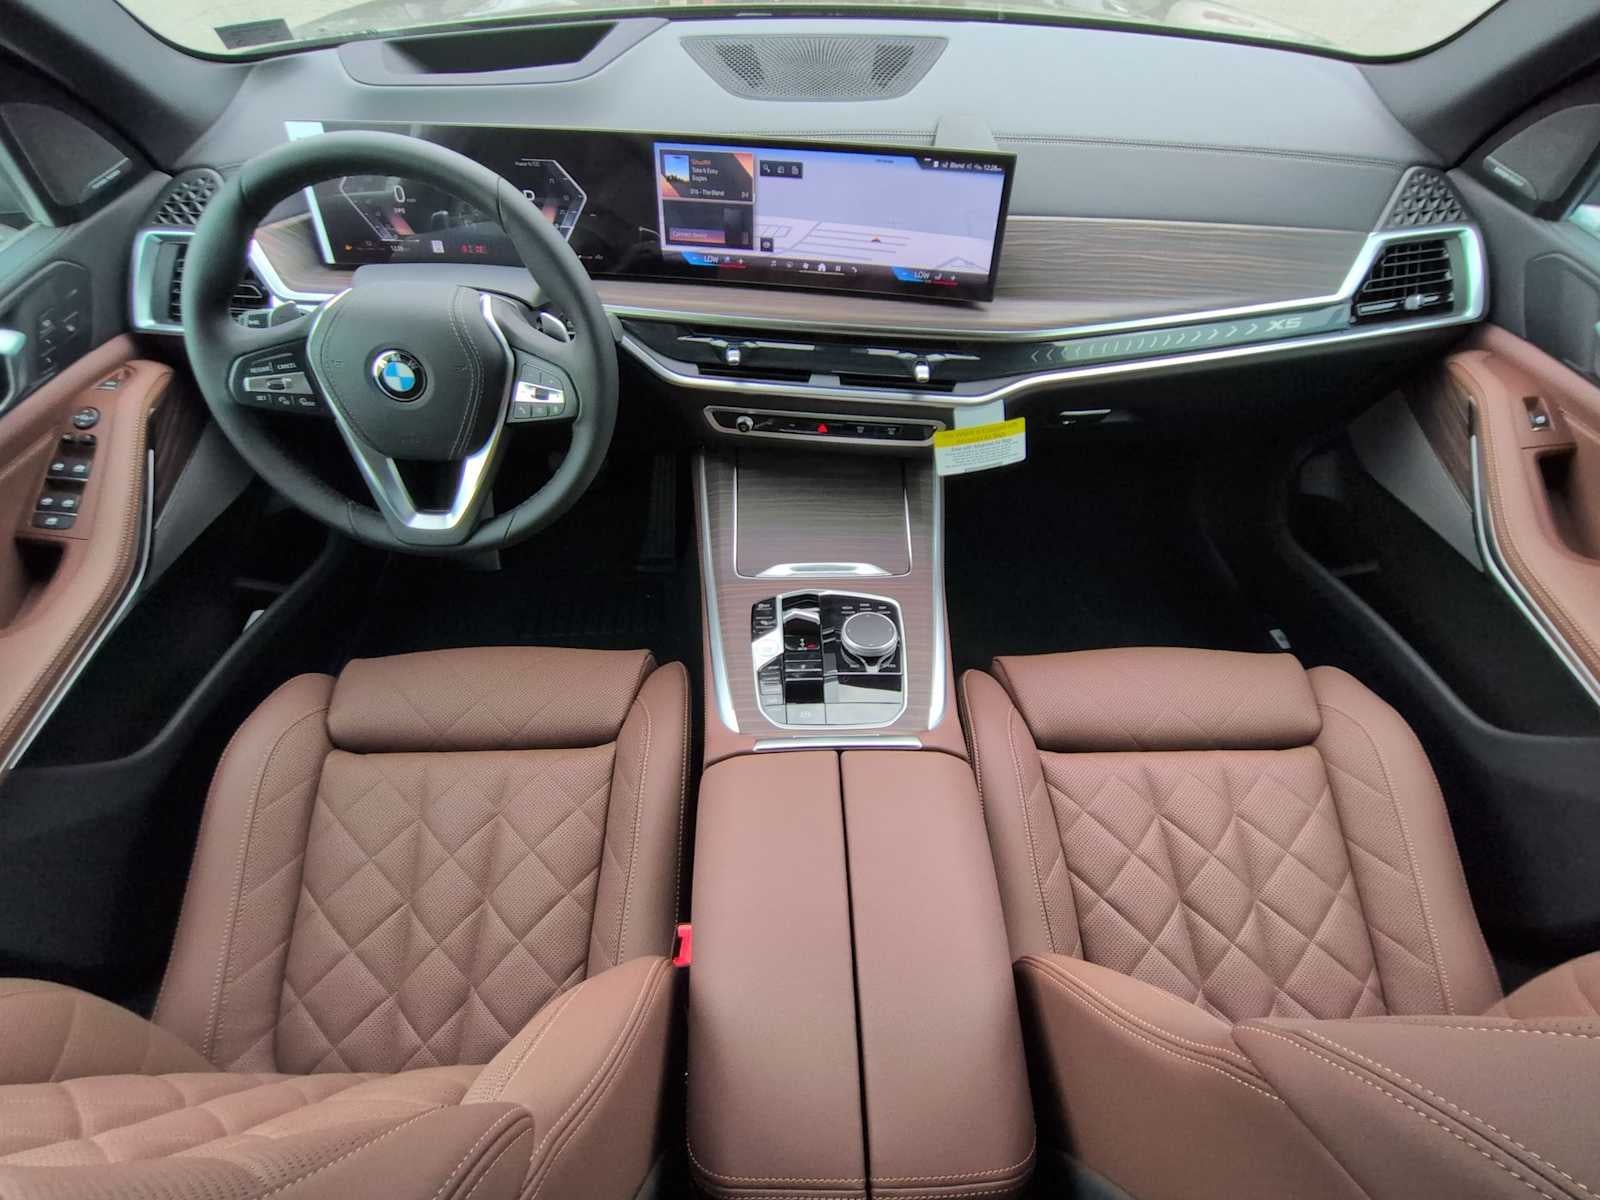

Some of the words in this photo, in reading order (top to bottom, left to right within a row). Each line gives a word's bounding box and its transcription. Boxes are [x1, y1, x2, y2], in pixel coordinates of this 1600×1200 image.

[703, 255, 719, 264] LOW
[914, 270, 930, 279] LOW
[1265, 316, 1303, 332] X5
